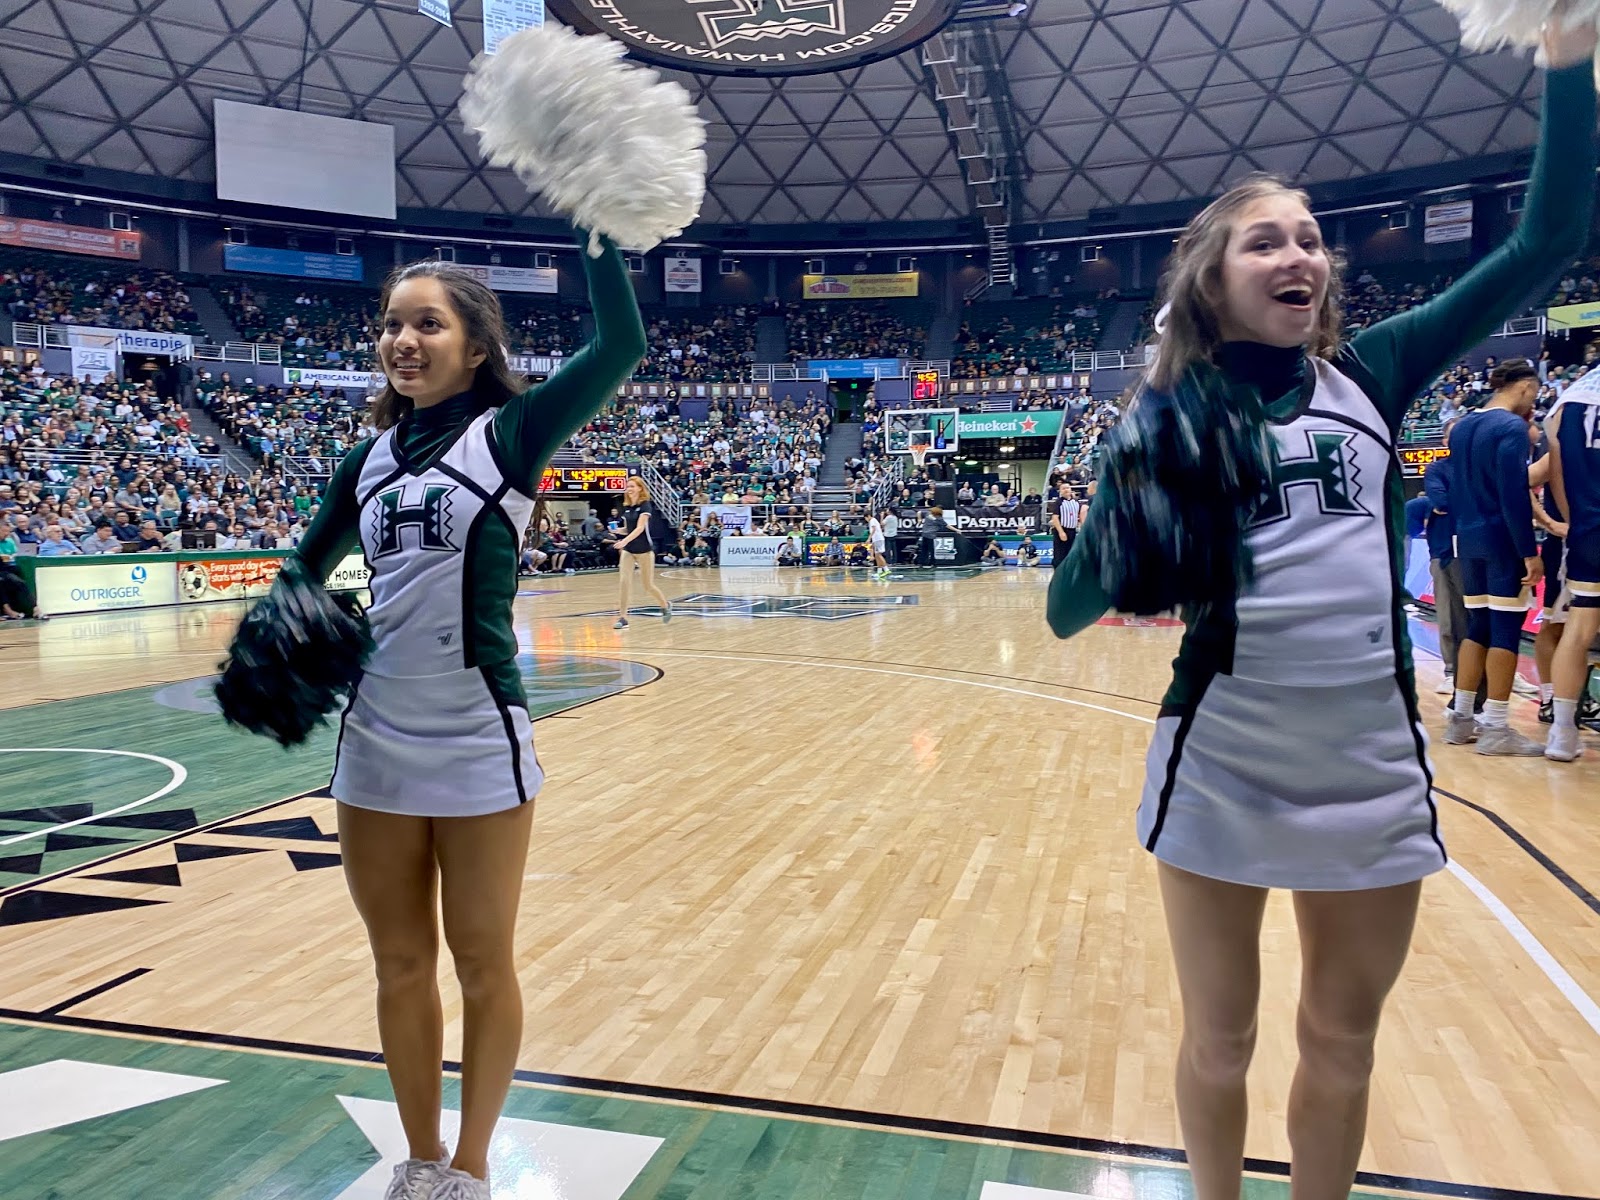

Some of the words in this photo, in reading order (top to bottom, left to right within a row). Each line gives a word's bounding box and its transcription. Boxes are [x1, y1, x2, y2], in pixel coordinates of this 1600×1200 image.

[117, 333, 182, 350] therapie
[528, 357, 561, 373] MILK
[304, 373, 350, 381] AMERICAN
[917, 372, 937, 382] 4:52
[914, 382, 935, 398] 27
[958, 420, 1017, 433] Heineken
[1405, 451, 1434, 462] 4:52
[571, 470, 596, 481] 4:52
[610, 480, 624, 489] 69
[957, 516, 1035, 528] PASTRAMI
[728, 547, 775, 555] HAWAIIAN
[229, 562, 245, 573] good
[246, 561, 259, 572] day
[335, 569, 368, 581] HOMES
[71, 586, 141, 601] OUTRIGGER
